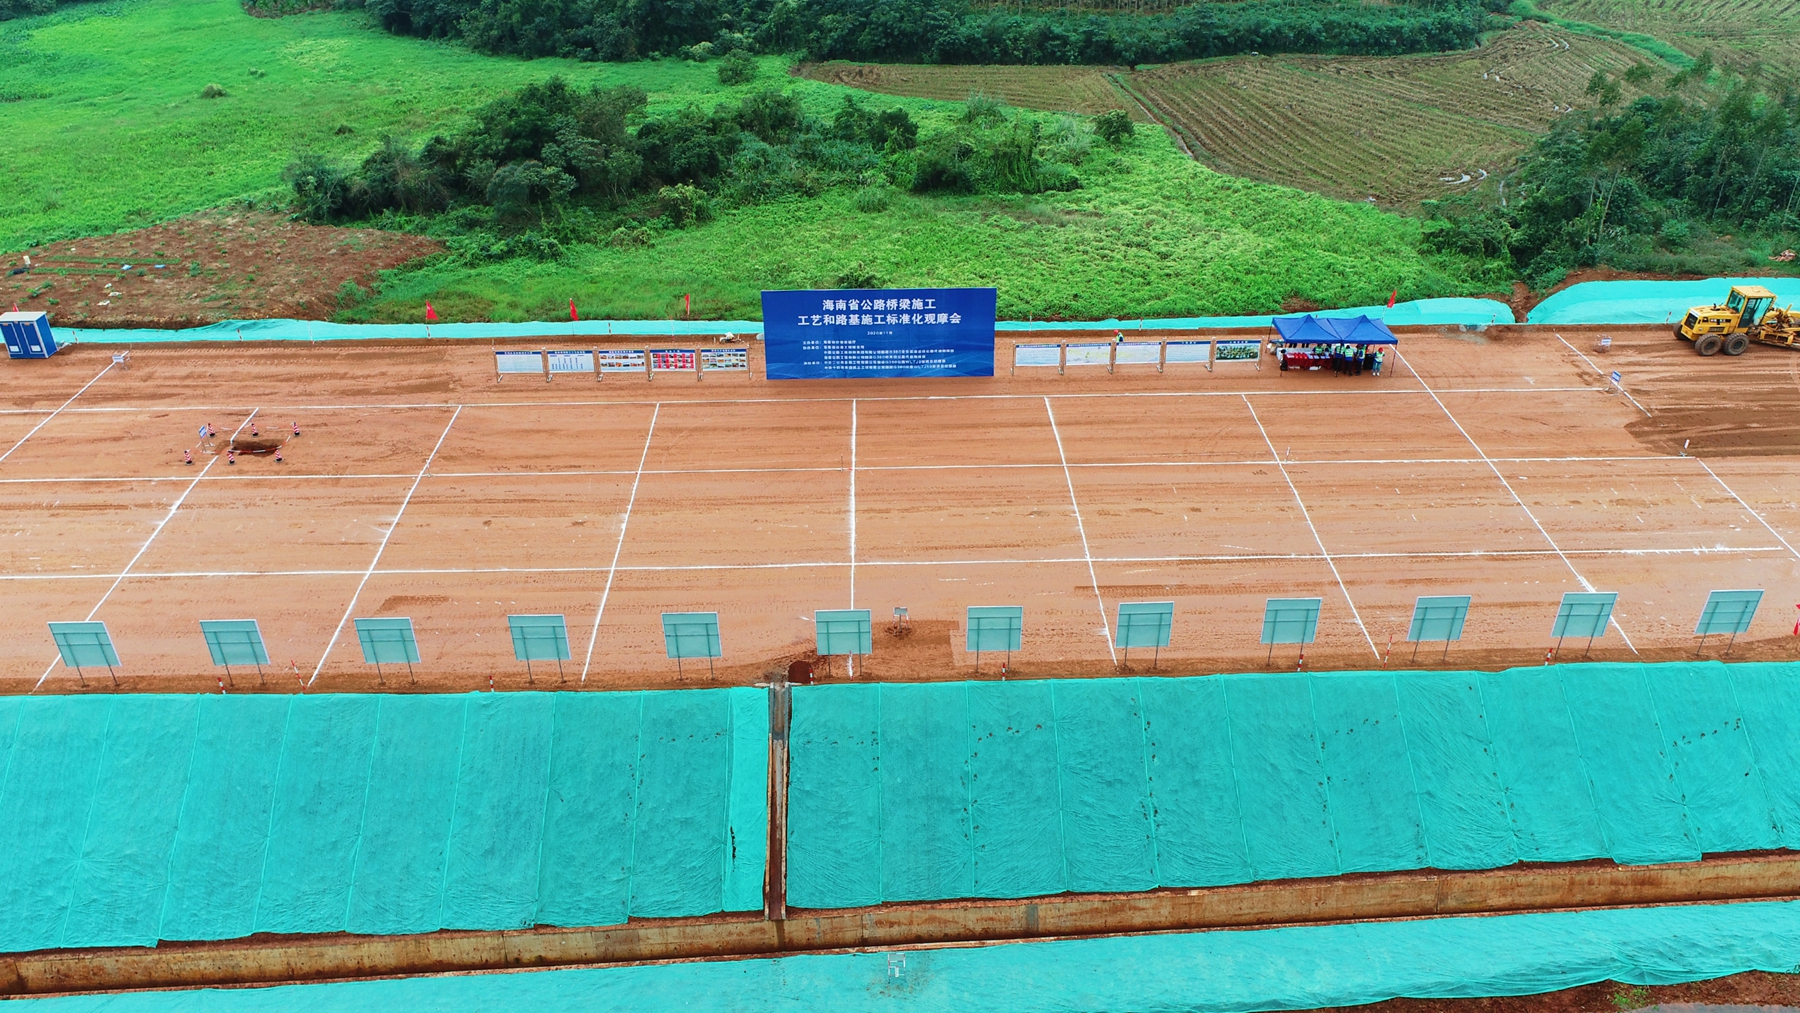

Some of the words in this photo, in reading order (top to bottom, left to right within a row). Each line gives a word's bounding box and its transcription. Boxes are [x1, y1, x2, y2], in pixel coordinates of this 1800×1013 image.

[822, 298, 937, 311] 海南省公路桥梁施工
[797, 312, 962, 327] 工艺和路基施工标准化观摩会
